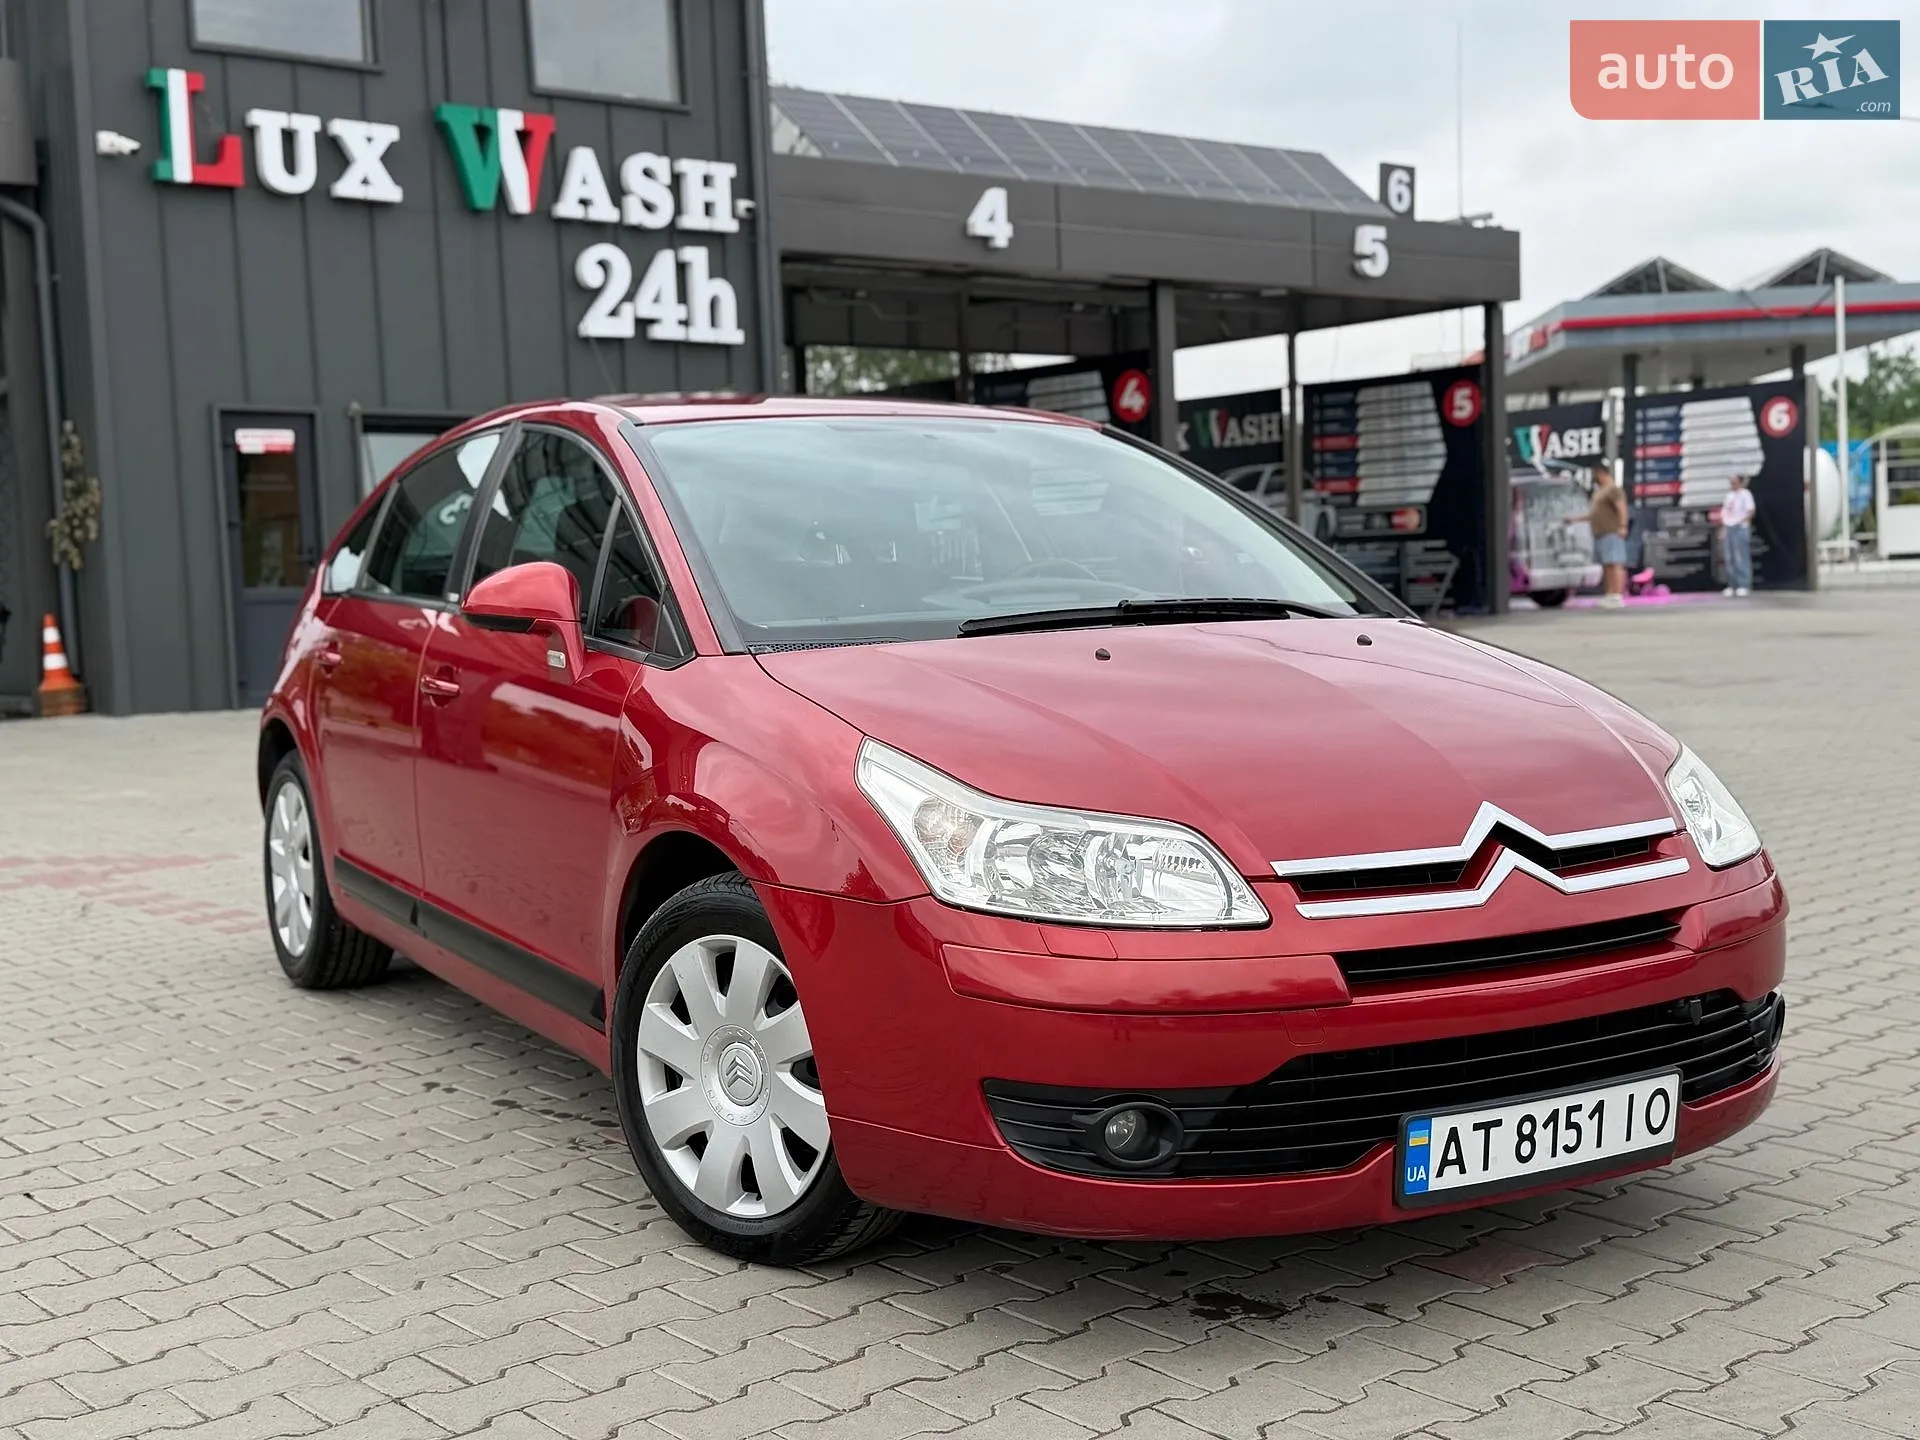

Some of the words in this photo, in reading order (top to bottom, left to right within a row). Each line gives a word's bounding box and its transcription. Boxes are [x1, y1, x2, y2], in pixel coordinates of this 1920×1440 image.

[146, 68, 403, 204] LUX
[435, 103, 740, 234] WASH
[1387, 169, 1412, 213] 6
[966, 186, 1013, 248] 4
[1353, 225, 1389, 278] 5
[574, 242, 745, 345] 24h
[1119, 377, 1146, 414] 4
[1452, 387, 1474, 420] 5
[1767, 402, 1791, 431] 6
[1514, 424, 1602, 464] WASH
[1435, 1118, 1503, 1179] AT
[1514, 1099, 1605, 1164] 8151
[1625, 1087, 1671, 1142] IO
[1407, 1164, 1427, 1183] UA
